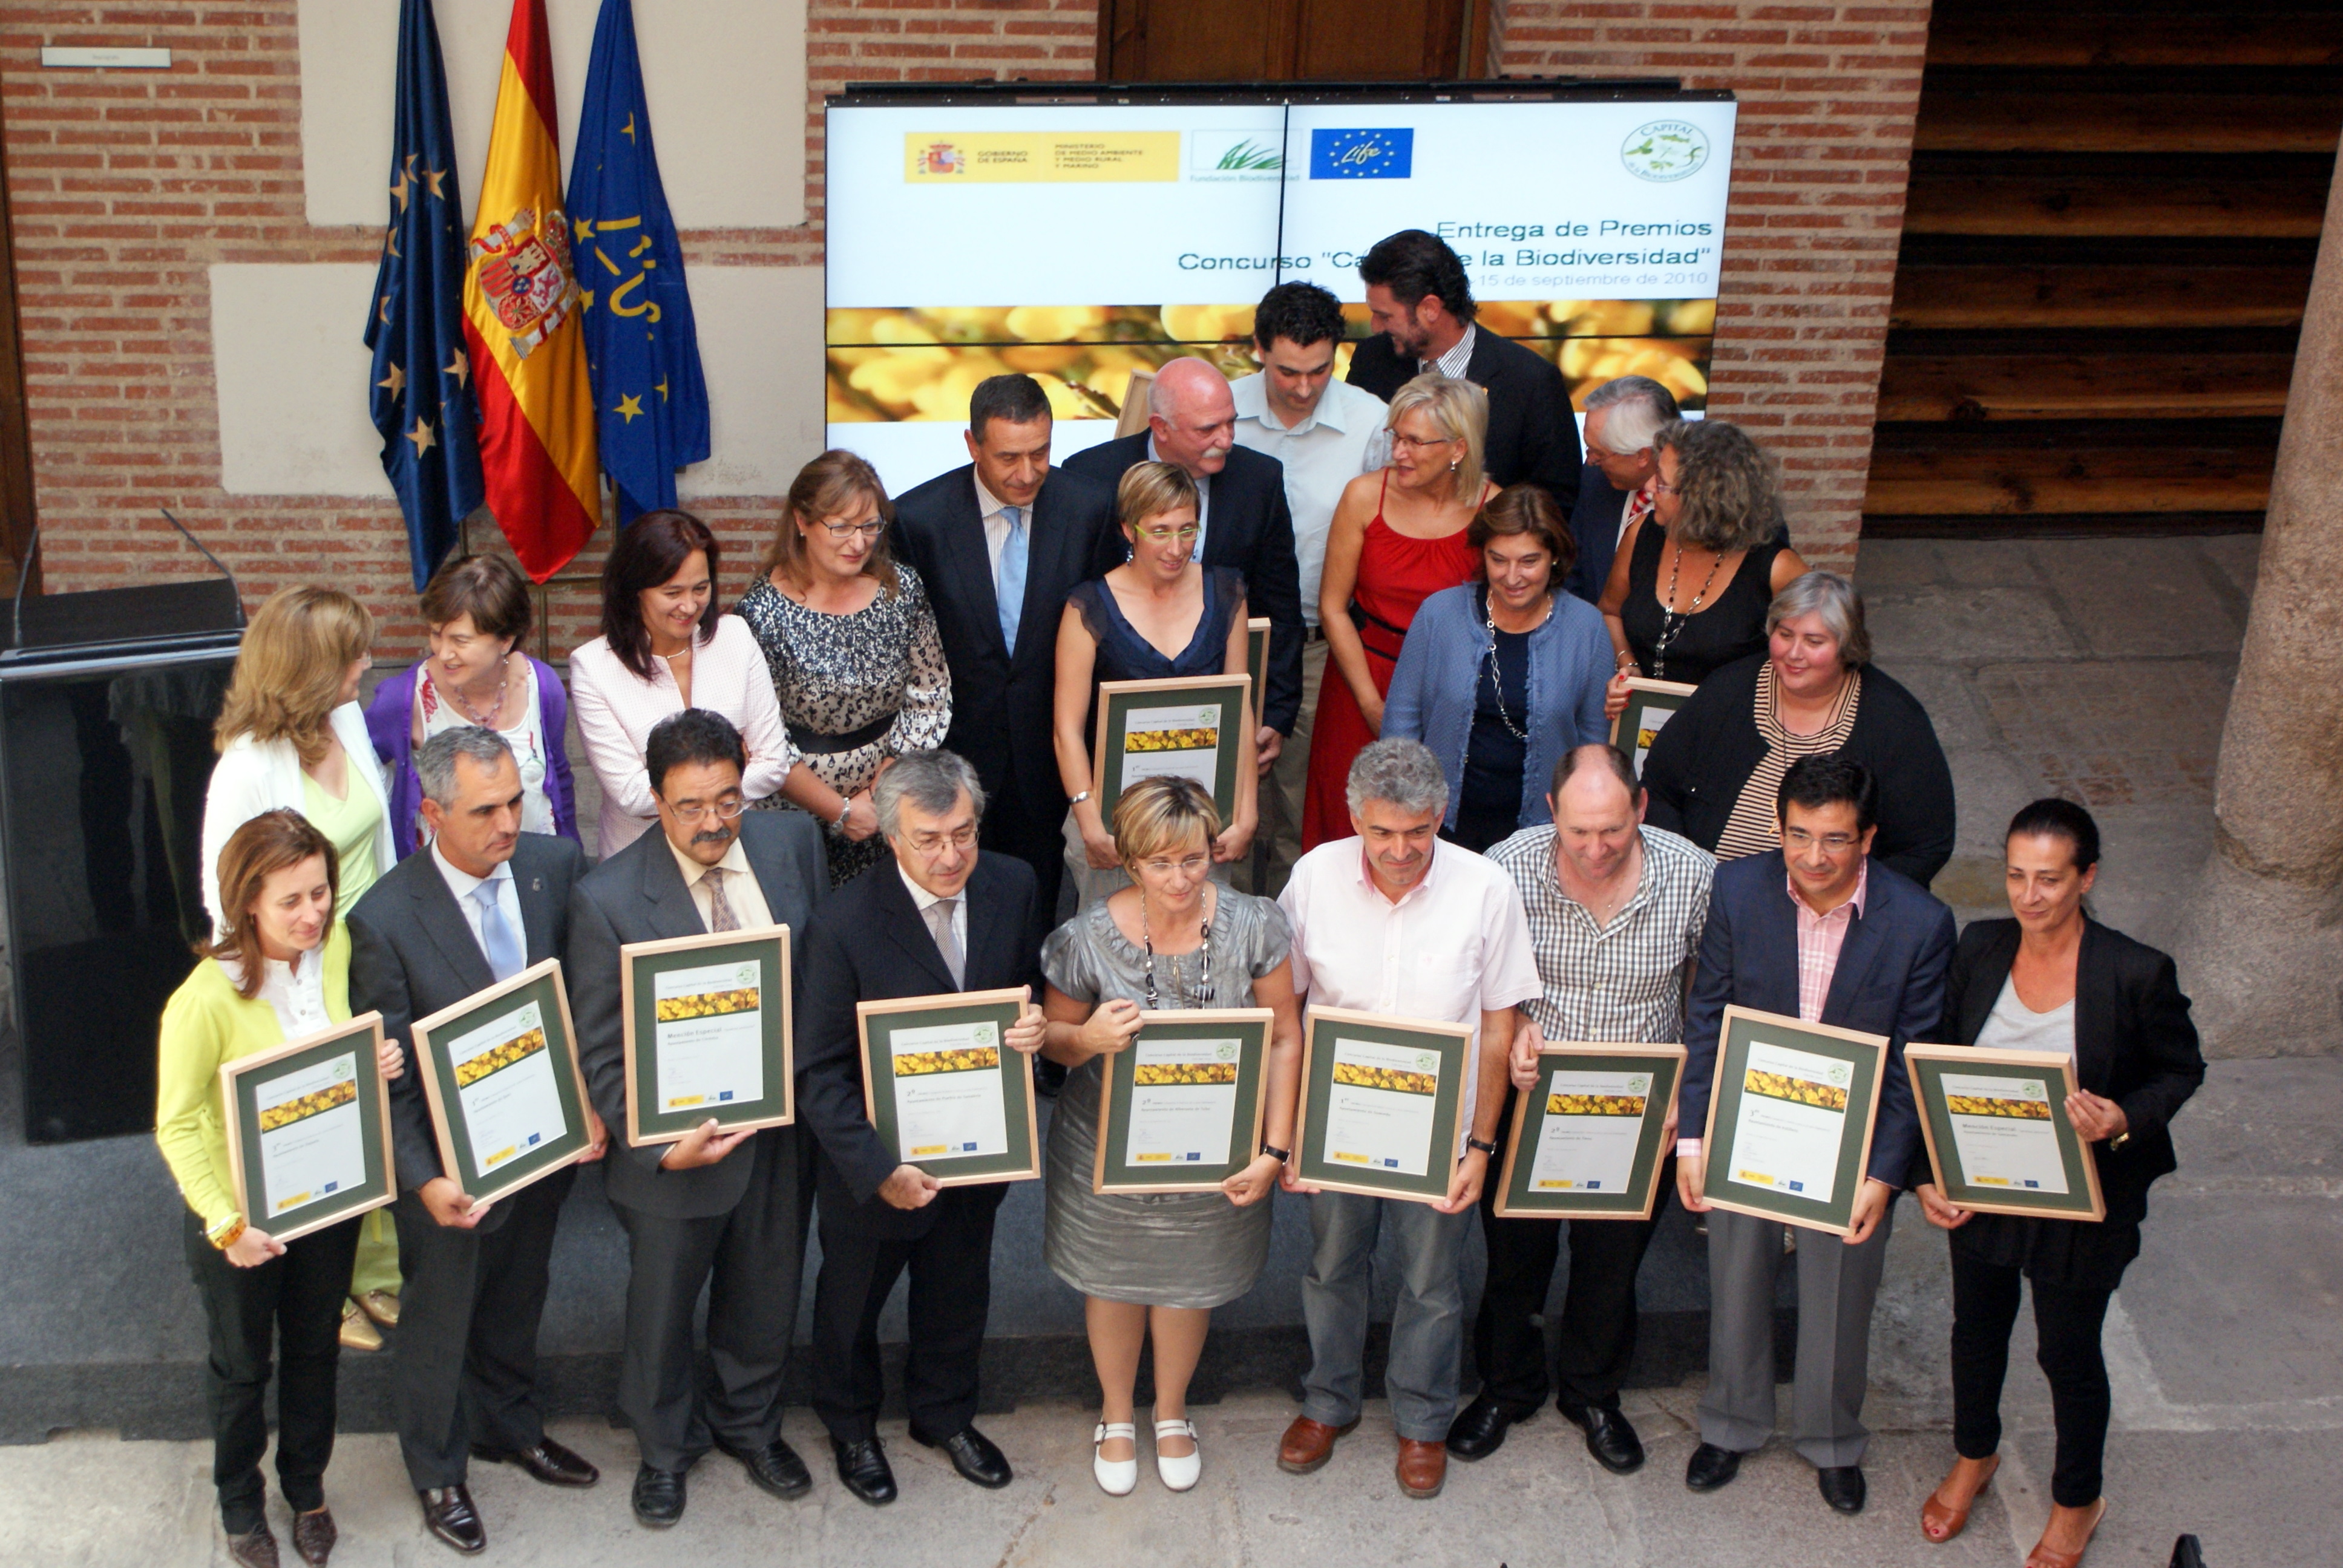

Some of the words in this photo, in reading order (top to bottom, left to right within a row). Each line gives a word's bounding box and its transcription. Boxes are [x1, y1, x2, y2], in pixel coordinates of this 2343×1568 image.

[1437, 221, 1544, 241] Entrega
[1556, 221, 1590, 237] de
[1600, 220, 1712, 237] Premios
[1178, 253, 1311, 270] Concurso
[1483, 250, 1504, 266] la
[1515, 248, 1711, 266] Biodiversidad"
[1479, 274, 1499, 287] 15
[1505, 275, 1526, 287] de
[1532, 272, 1631, 289] septiembre
[1636, 273, 1658, 286] de
[1663, 272, 1709, 286] 2010
